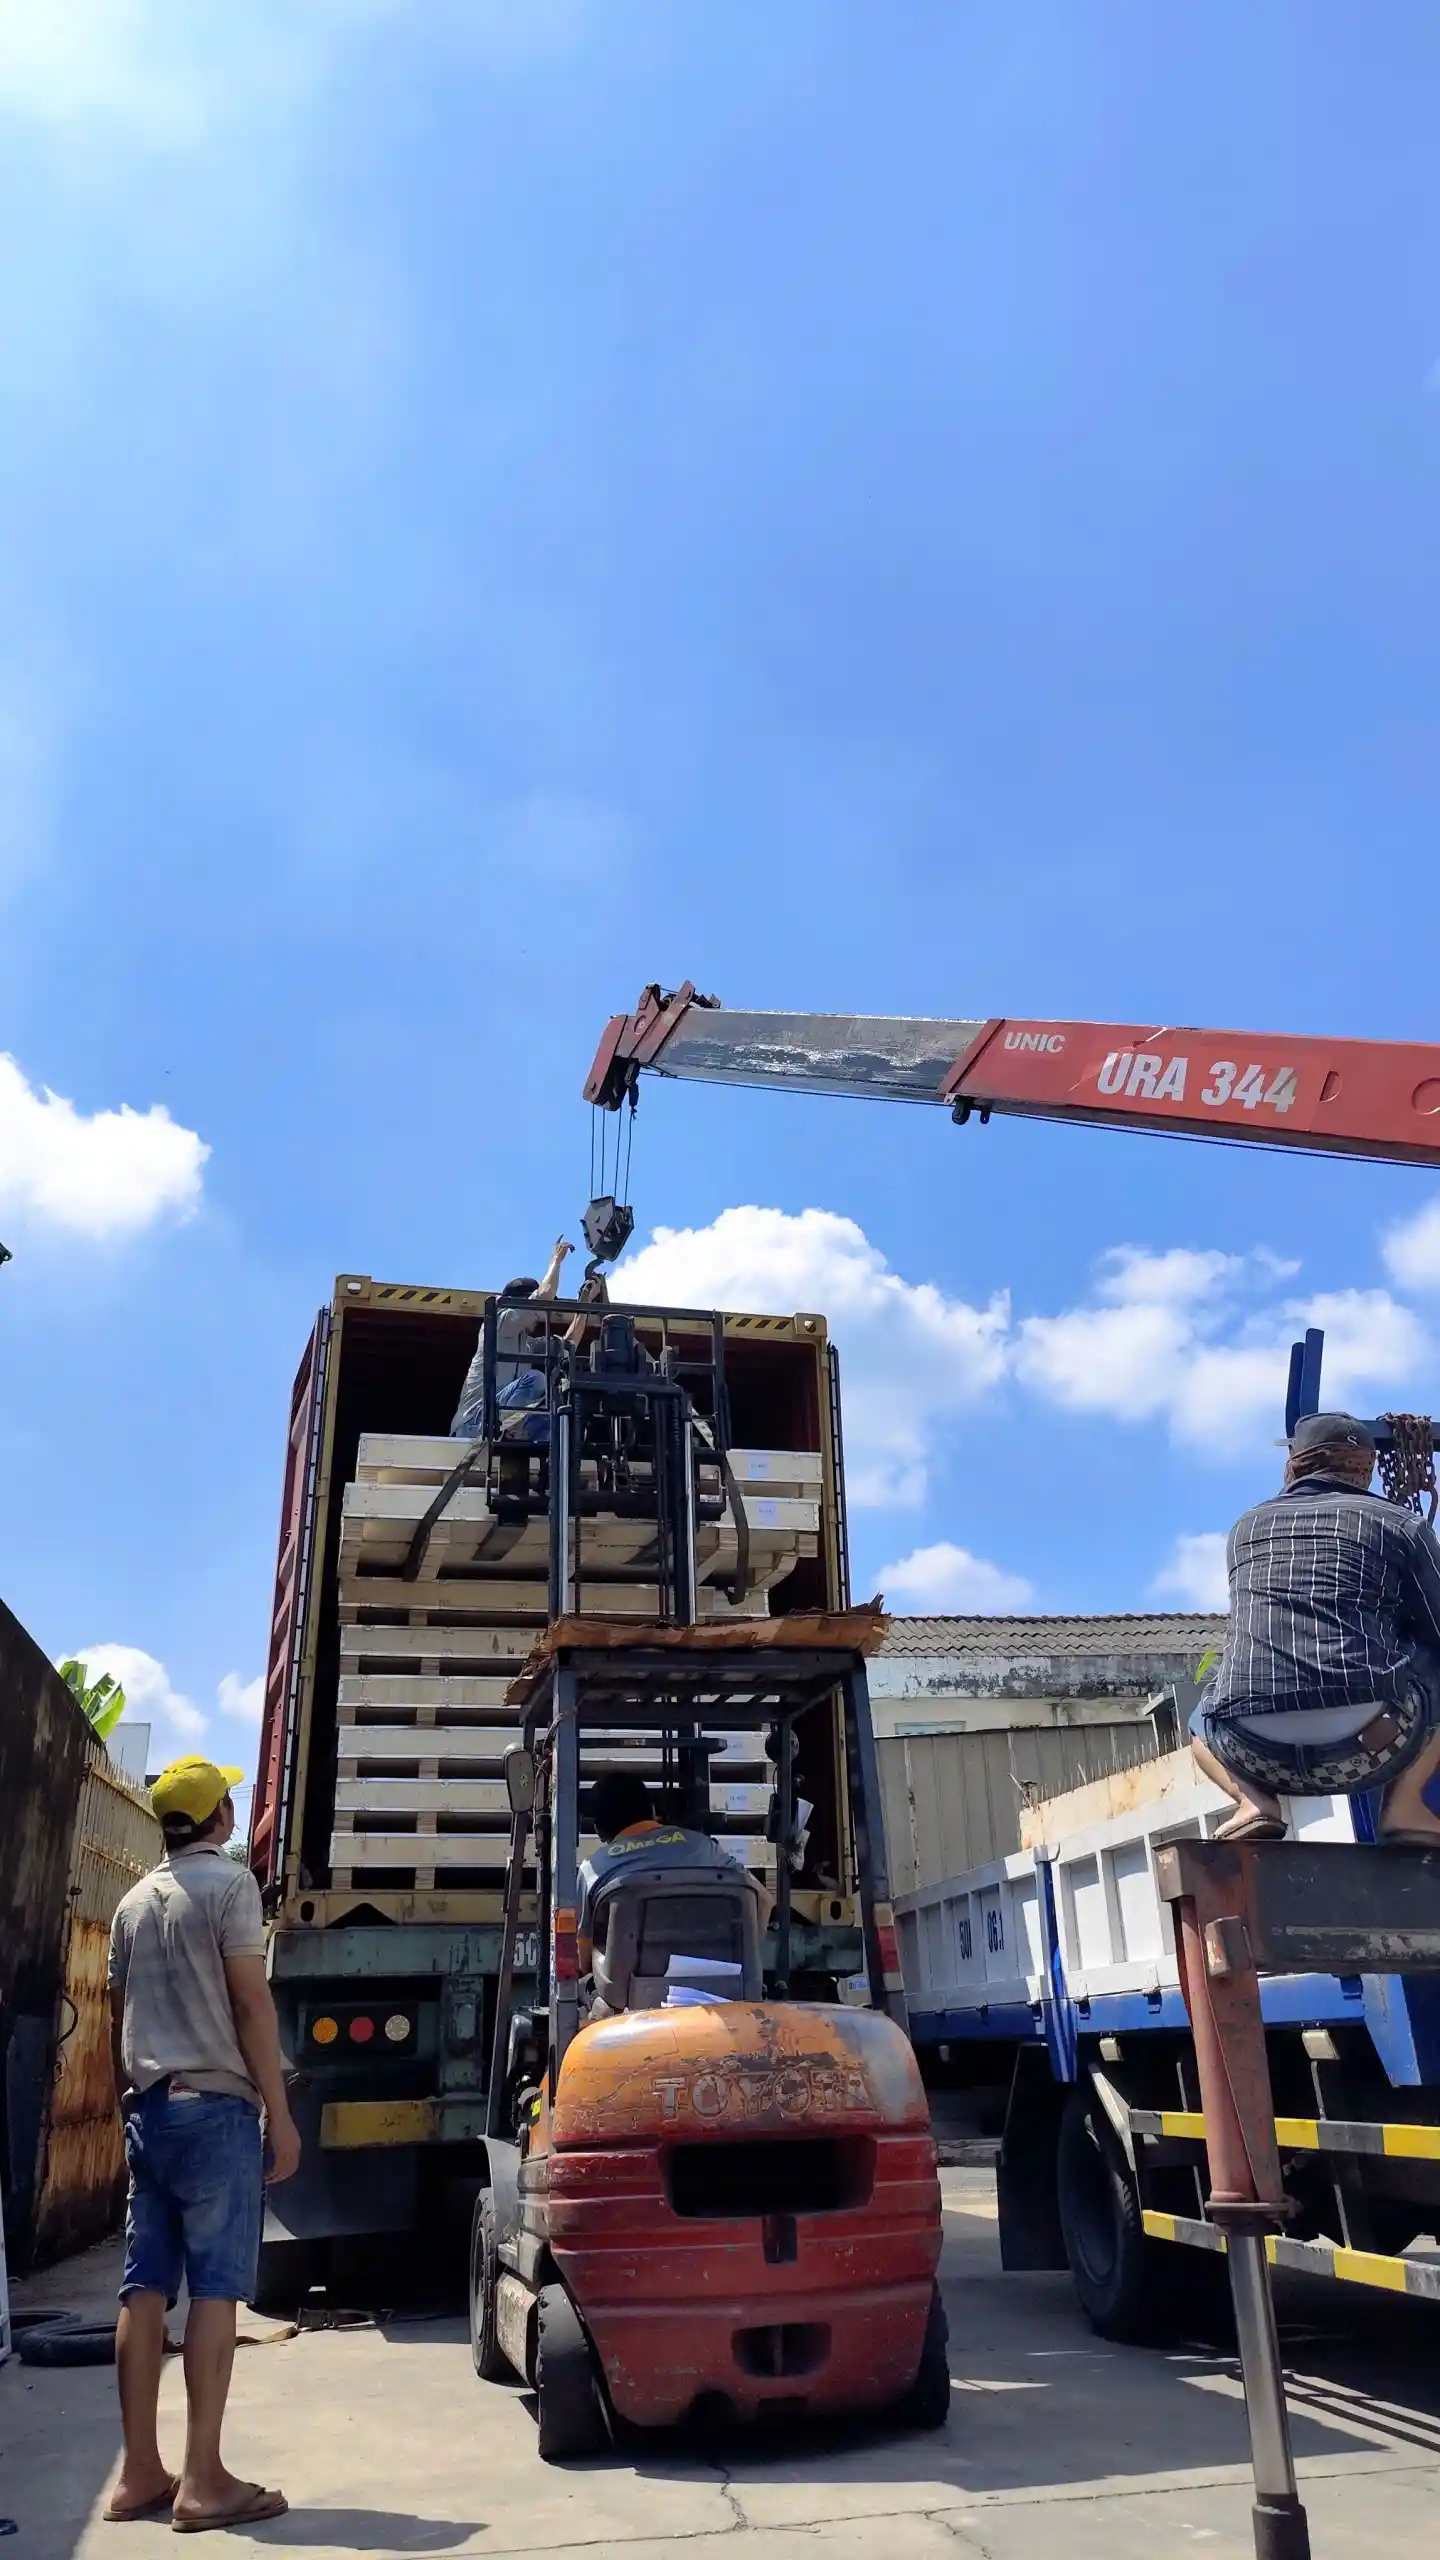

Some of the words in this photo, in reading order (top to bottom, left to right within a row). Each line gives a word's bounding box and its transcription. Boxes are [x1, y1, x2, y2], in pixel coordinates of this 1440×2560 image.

[1003, 1032, 1065, 1053] UNIC
[1097, 1051, 1189, 1101] URA
[1201, 1061, 1299, 1113] 344
[652, 2066, 877, 2122] TOYOTA
